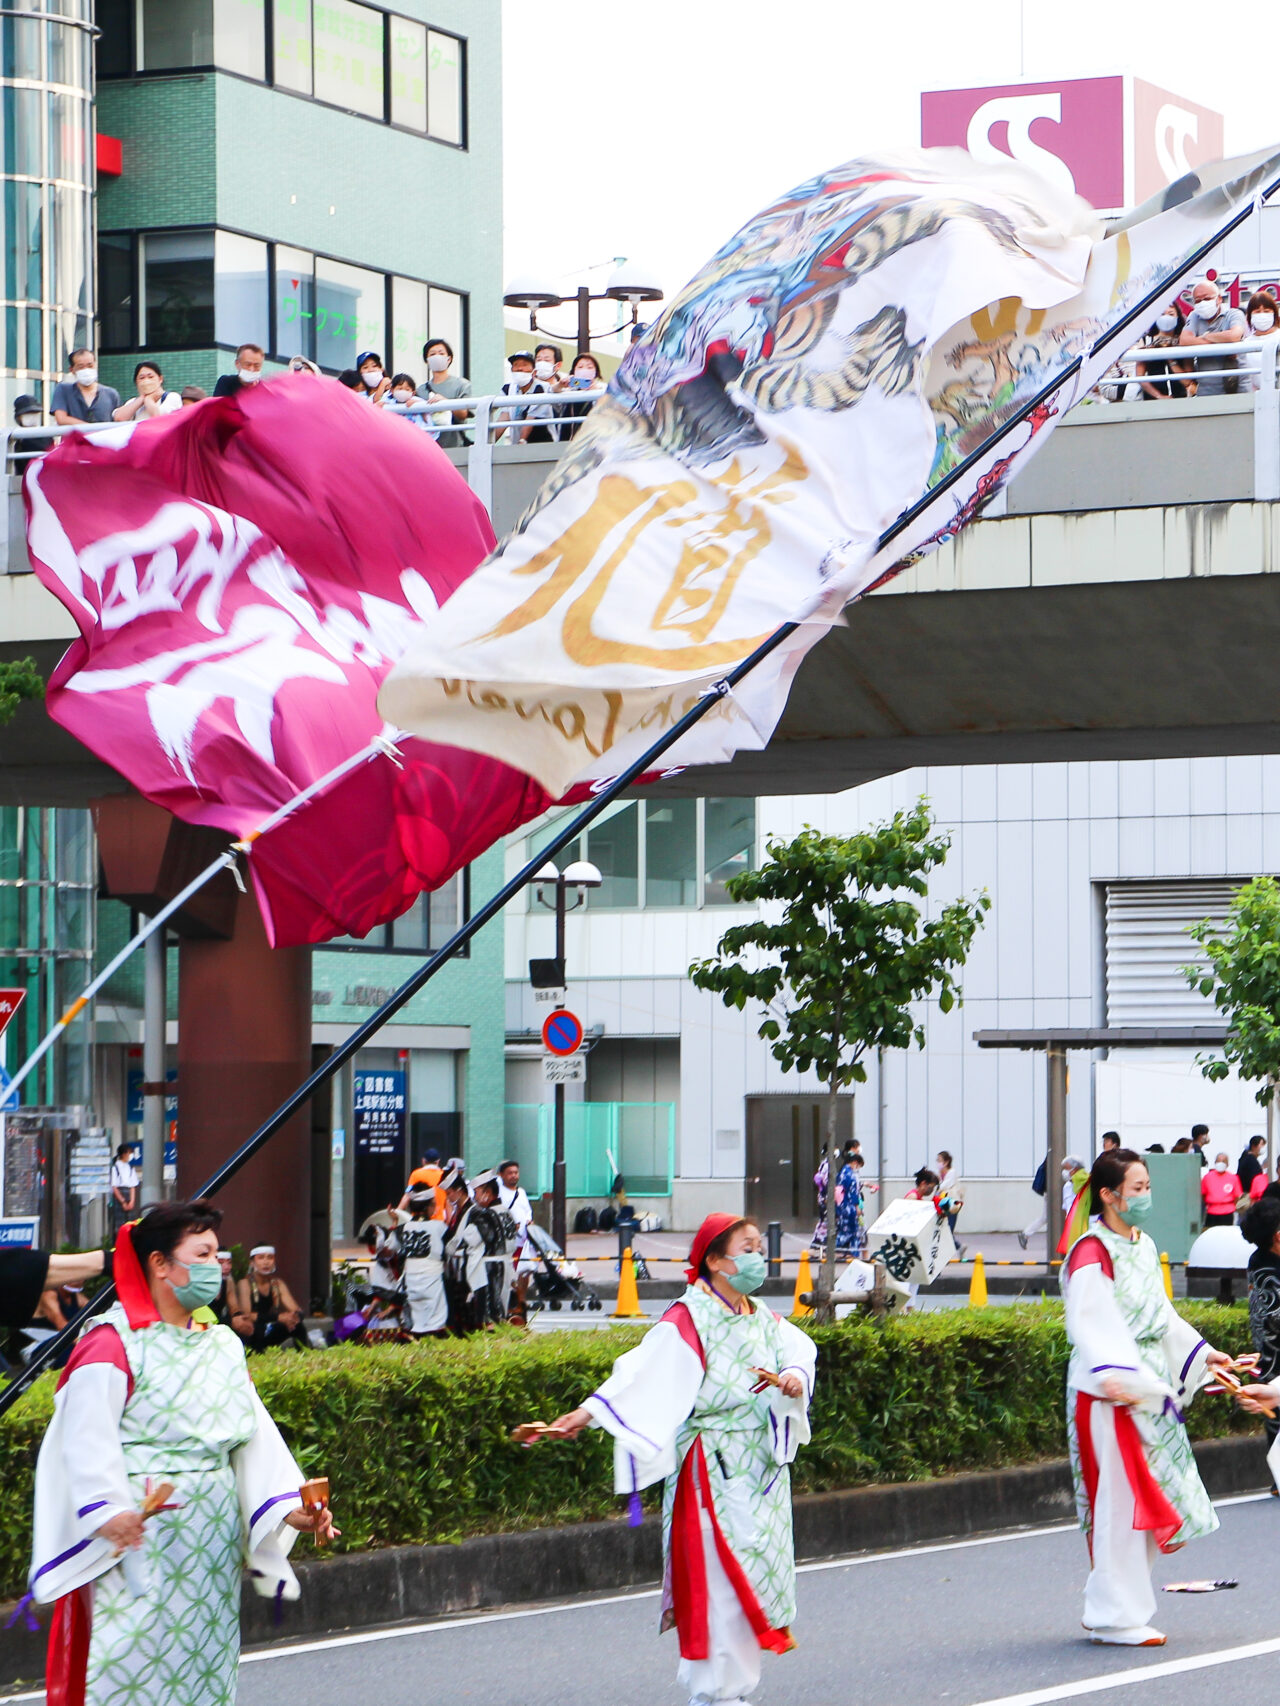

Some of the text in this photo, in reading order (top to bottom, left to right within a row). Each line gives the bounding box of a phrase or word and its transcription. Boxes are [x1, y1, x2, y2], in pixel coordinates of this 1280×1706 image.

[365, 1077, 394, 1092] 図書館
[355, 1095, 404, 1110] 上尾駅前分館
